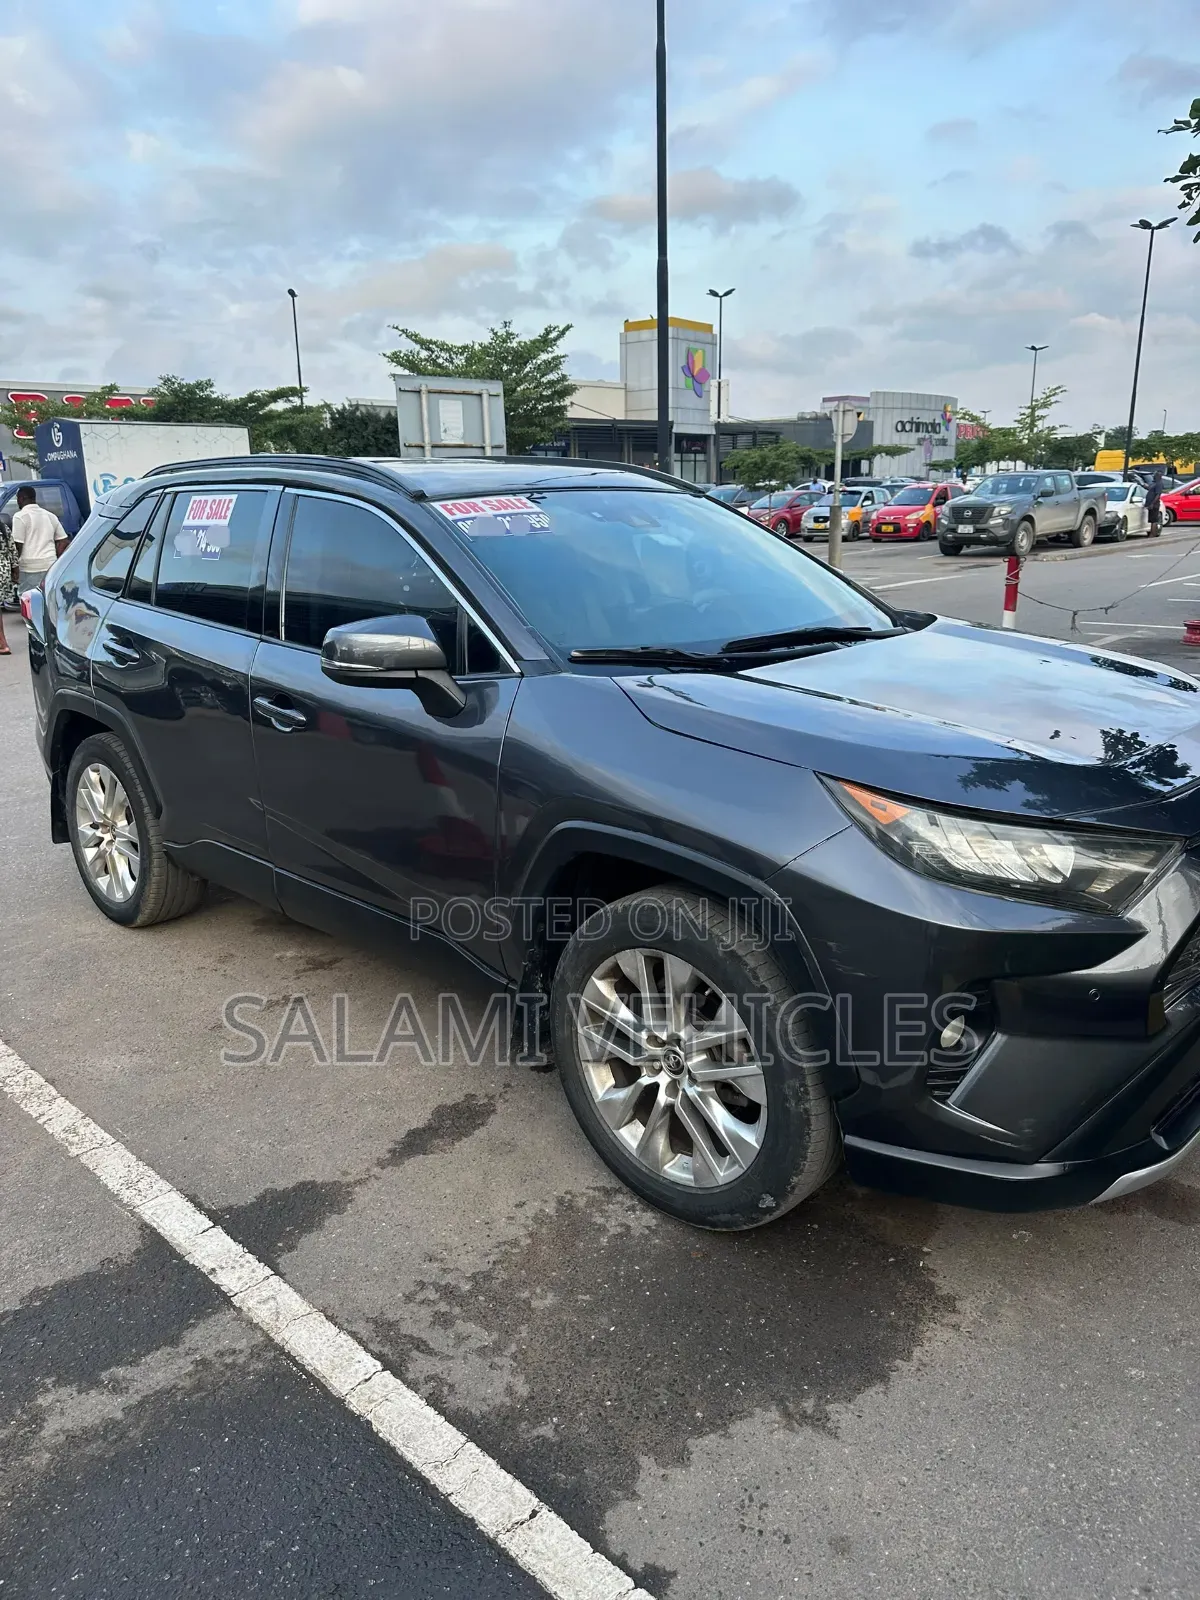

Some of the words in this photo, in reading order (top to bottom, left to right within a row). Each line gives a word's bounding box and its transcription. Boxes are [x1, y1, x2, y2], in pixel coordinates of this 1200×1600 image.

[895, 416, 941, 434] achimota
[187, 499, 208, 521] FOR
[205, 498, 233, 520] SALE
[438, 501, 487, 516] FOR
[481, 498, 534, 511] SALE
